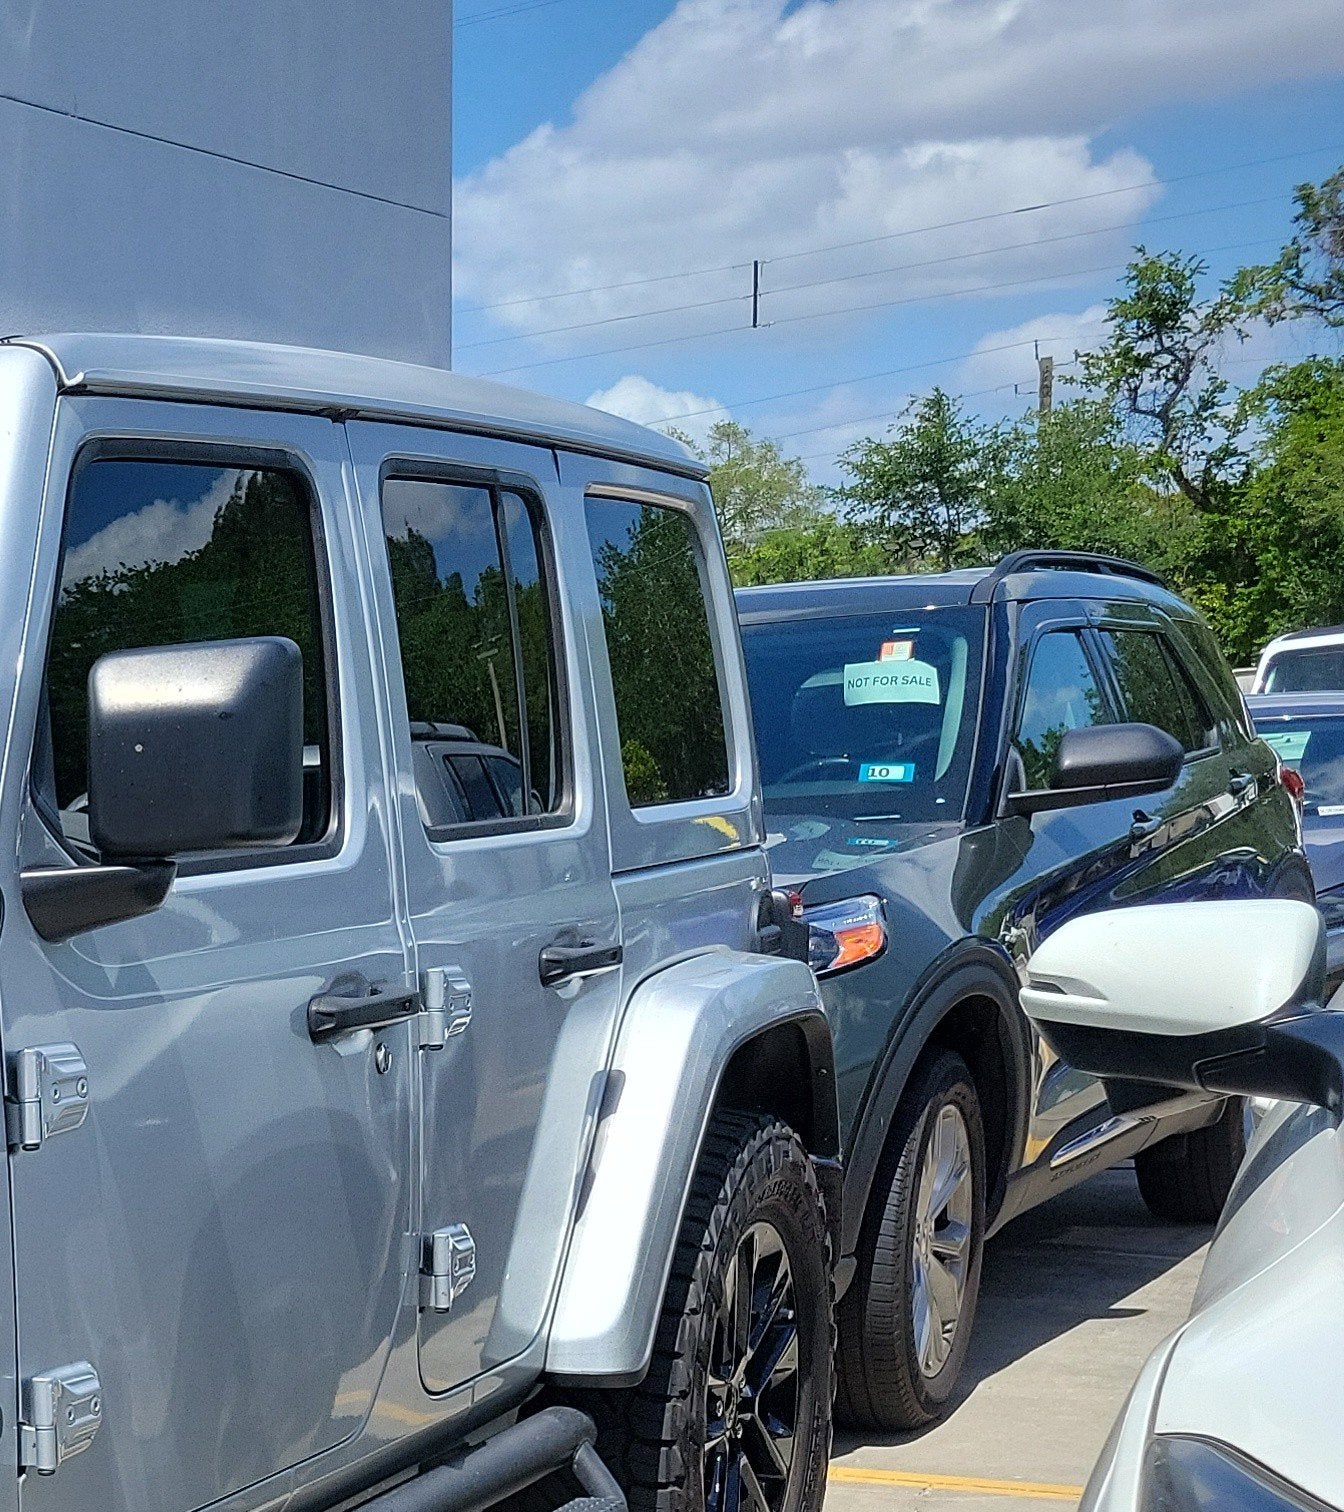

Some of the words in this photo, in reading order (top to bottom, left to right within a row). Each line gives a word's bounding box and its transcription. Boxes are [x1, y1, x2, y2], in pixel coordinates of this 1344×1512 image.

[847, 676, 870, 689] NOT
[872, 675, 898, 687] FOR
[901, 675, 932, 687] SALE
[868, 767, 890, 778] 10
